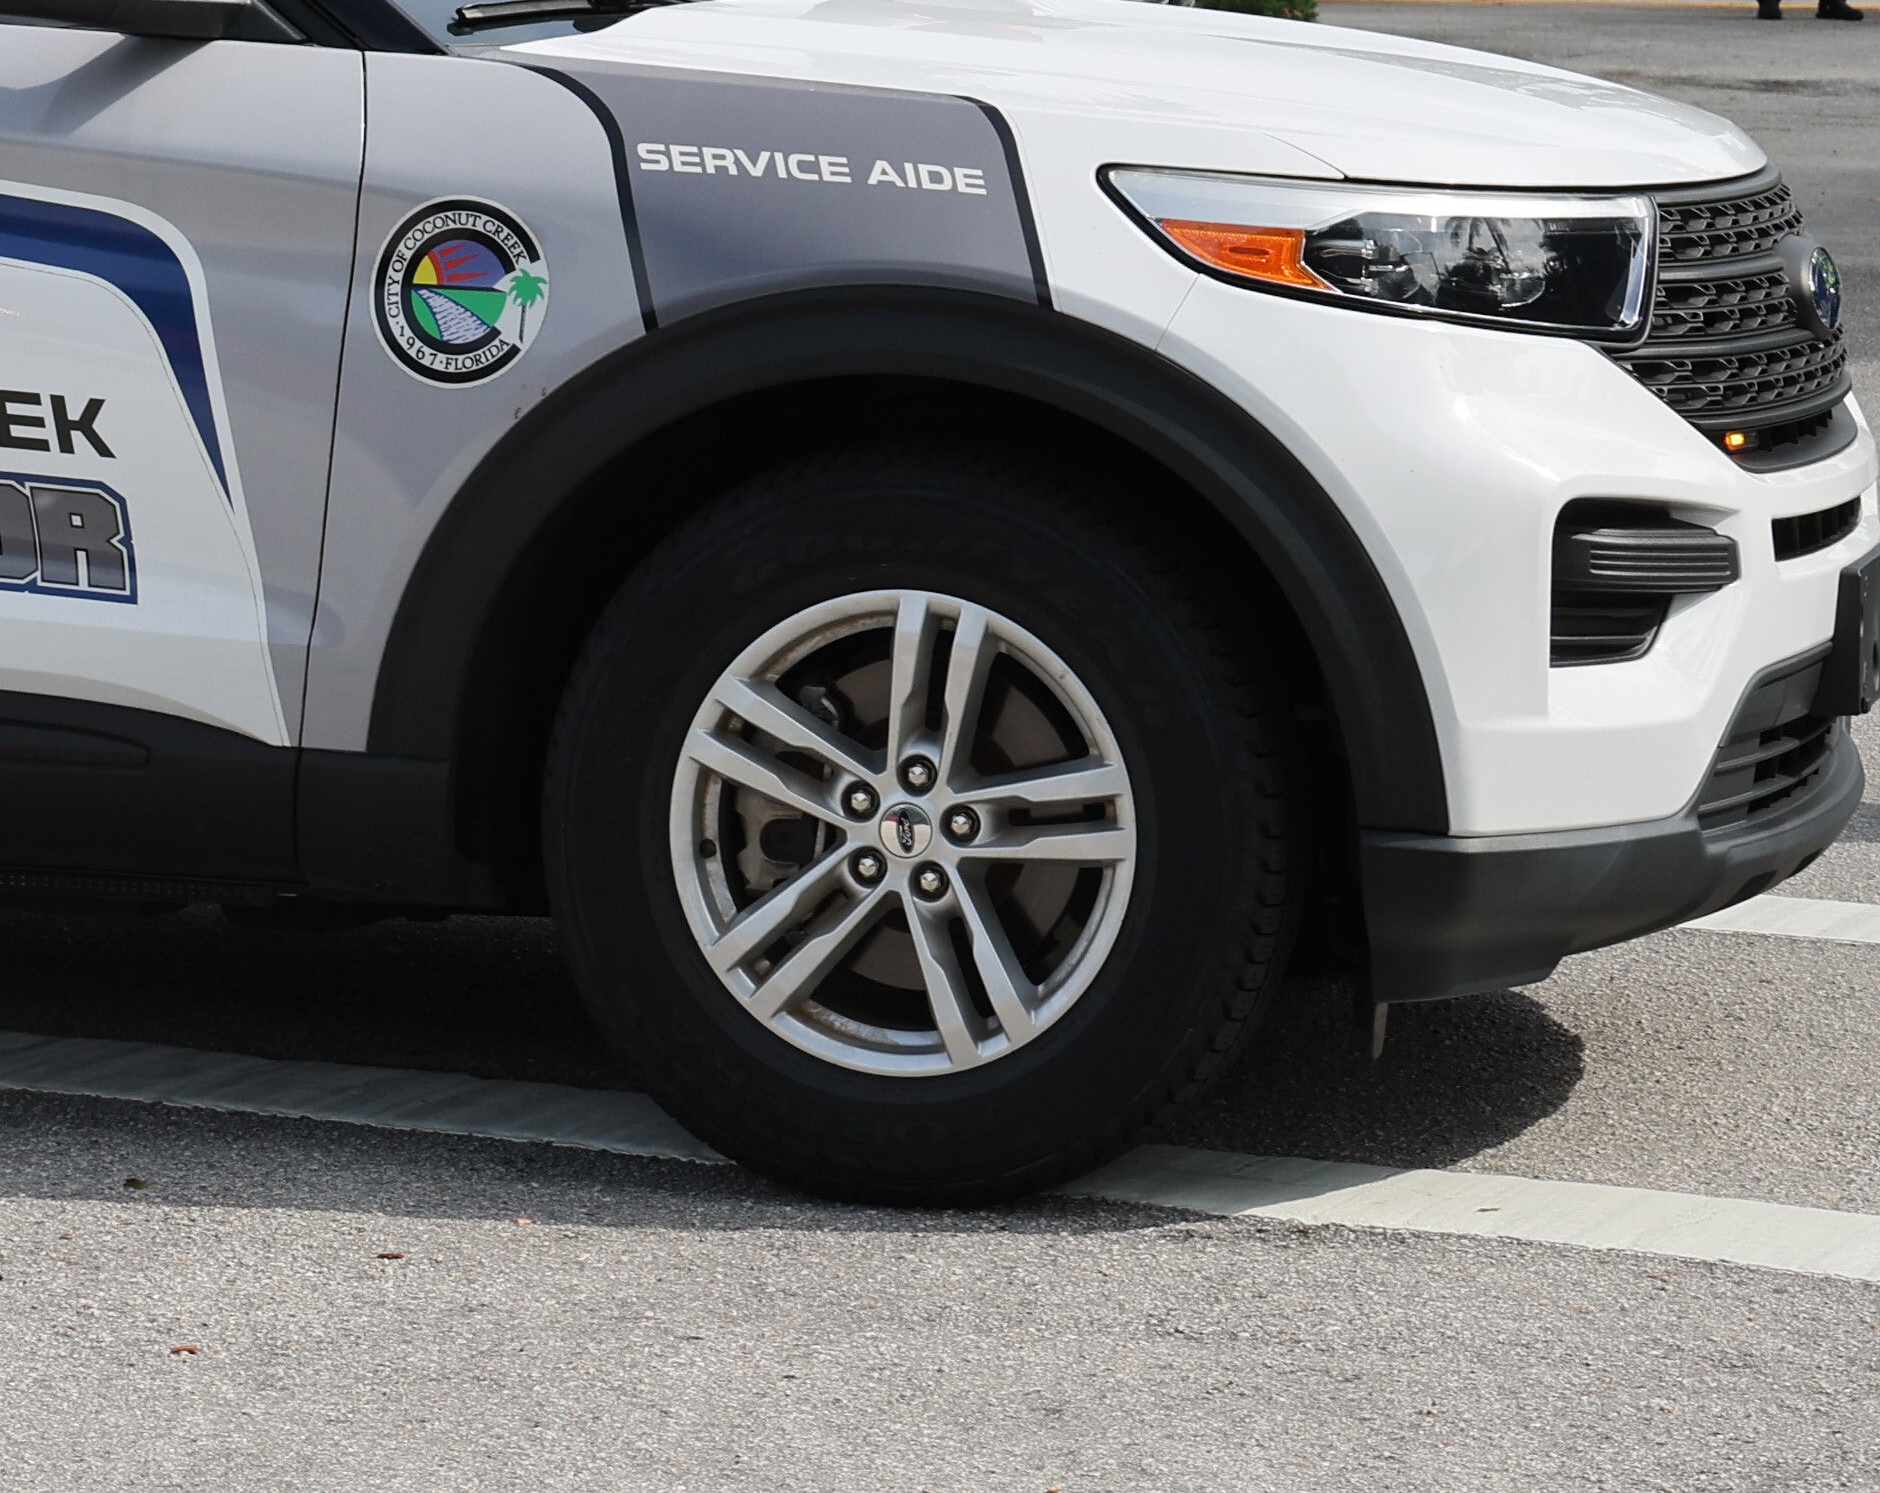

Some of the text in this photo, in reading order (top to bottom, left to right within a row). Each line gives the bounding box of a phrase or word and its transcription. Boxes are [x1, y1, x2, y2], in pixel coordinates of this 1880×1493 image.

[636, 142, 987, 196] SERVICE AIDE
[386, 212, 527, 319] CITY OF COCONUT CREEK
[444, 338, 511, 371] FLORIDA
